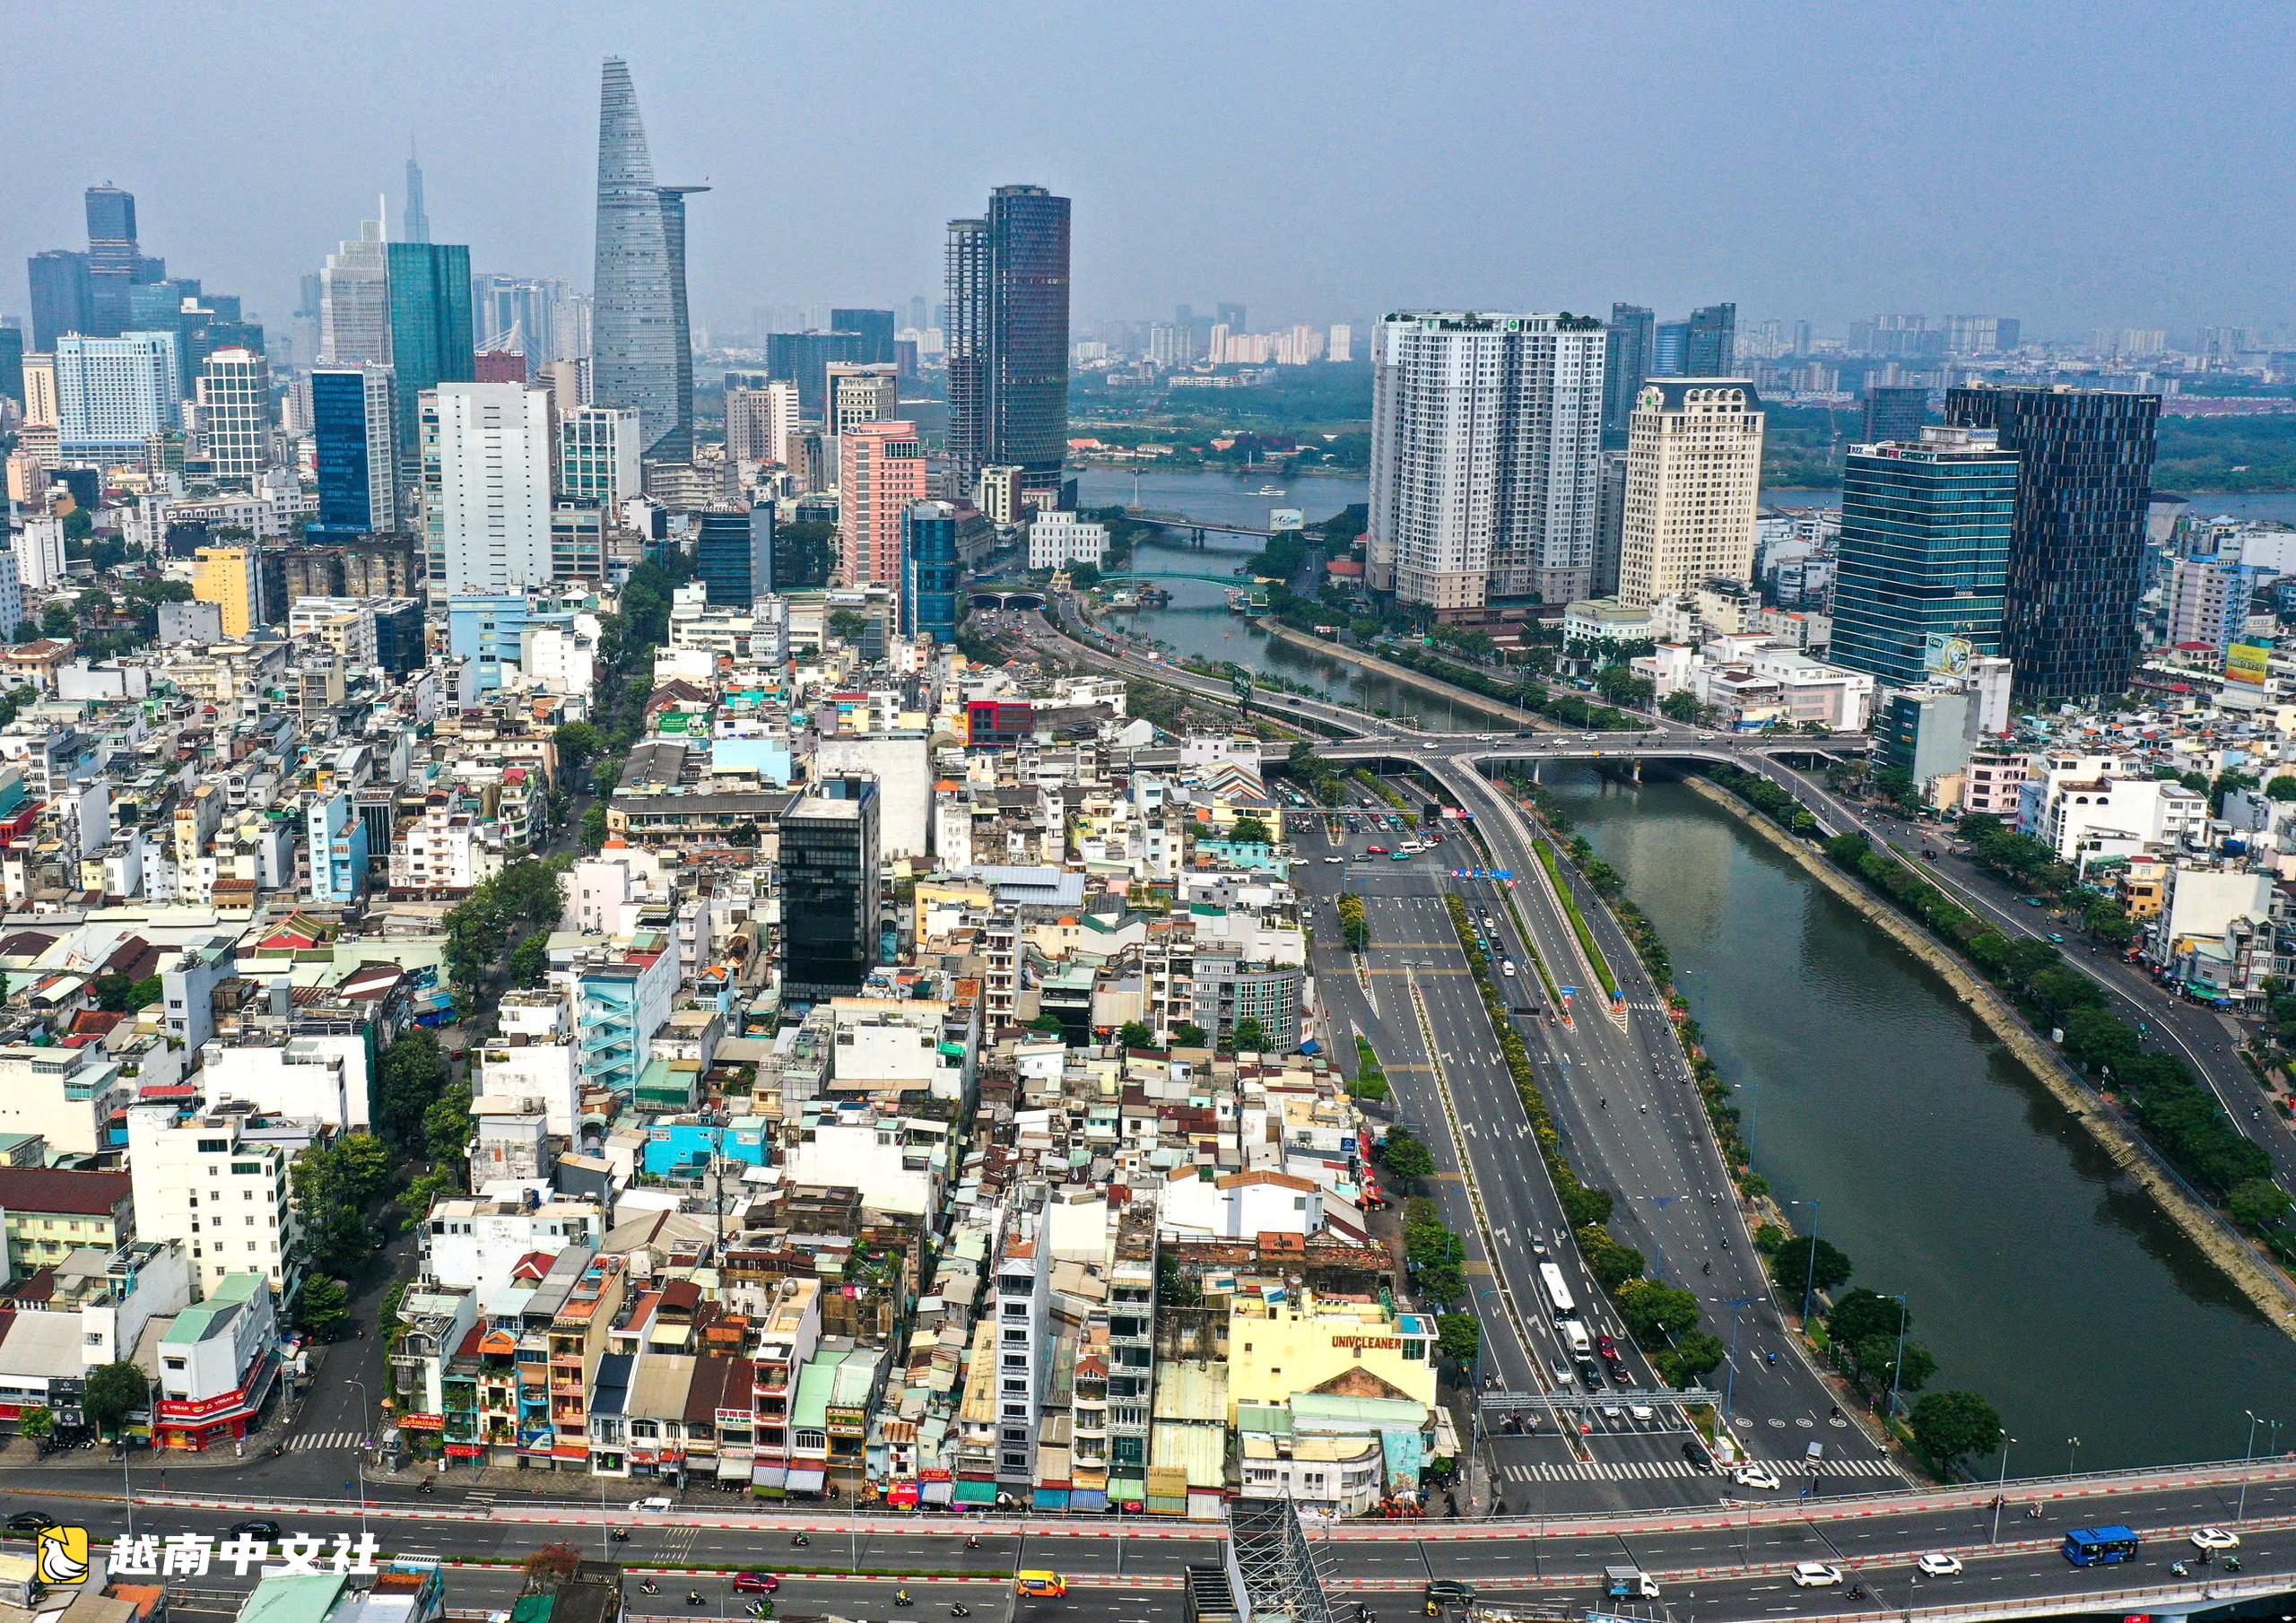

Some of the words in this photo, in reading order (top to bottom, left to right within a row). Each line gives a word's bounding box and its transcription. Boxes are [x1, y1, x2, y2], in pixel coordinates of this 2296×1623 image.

[1900, 451, 1935, 462] CREDIT
[1332, 1336, 1401, 1350] UNIVCLEANER
[214, 1396, 234, 1405] VISSAN
